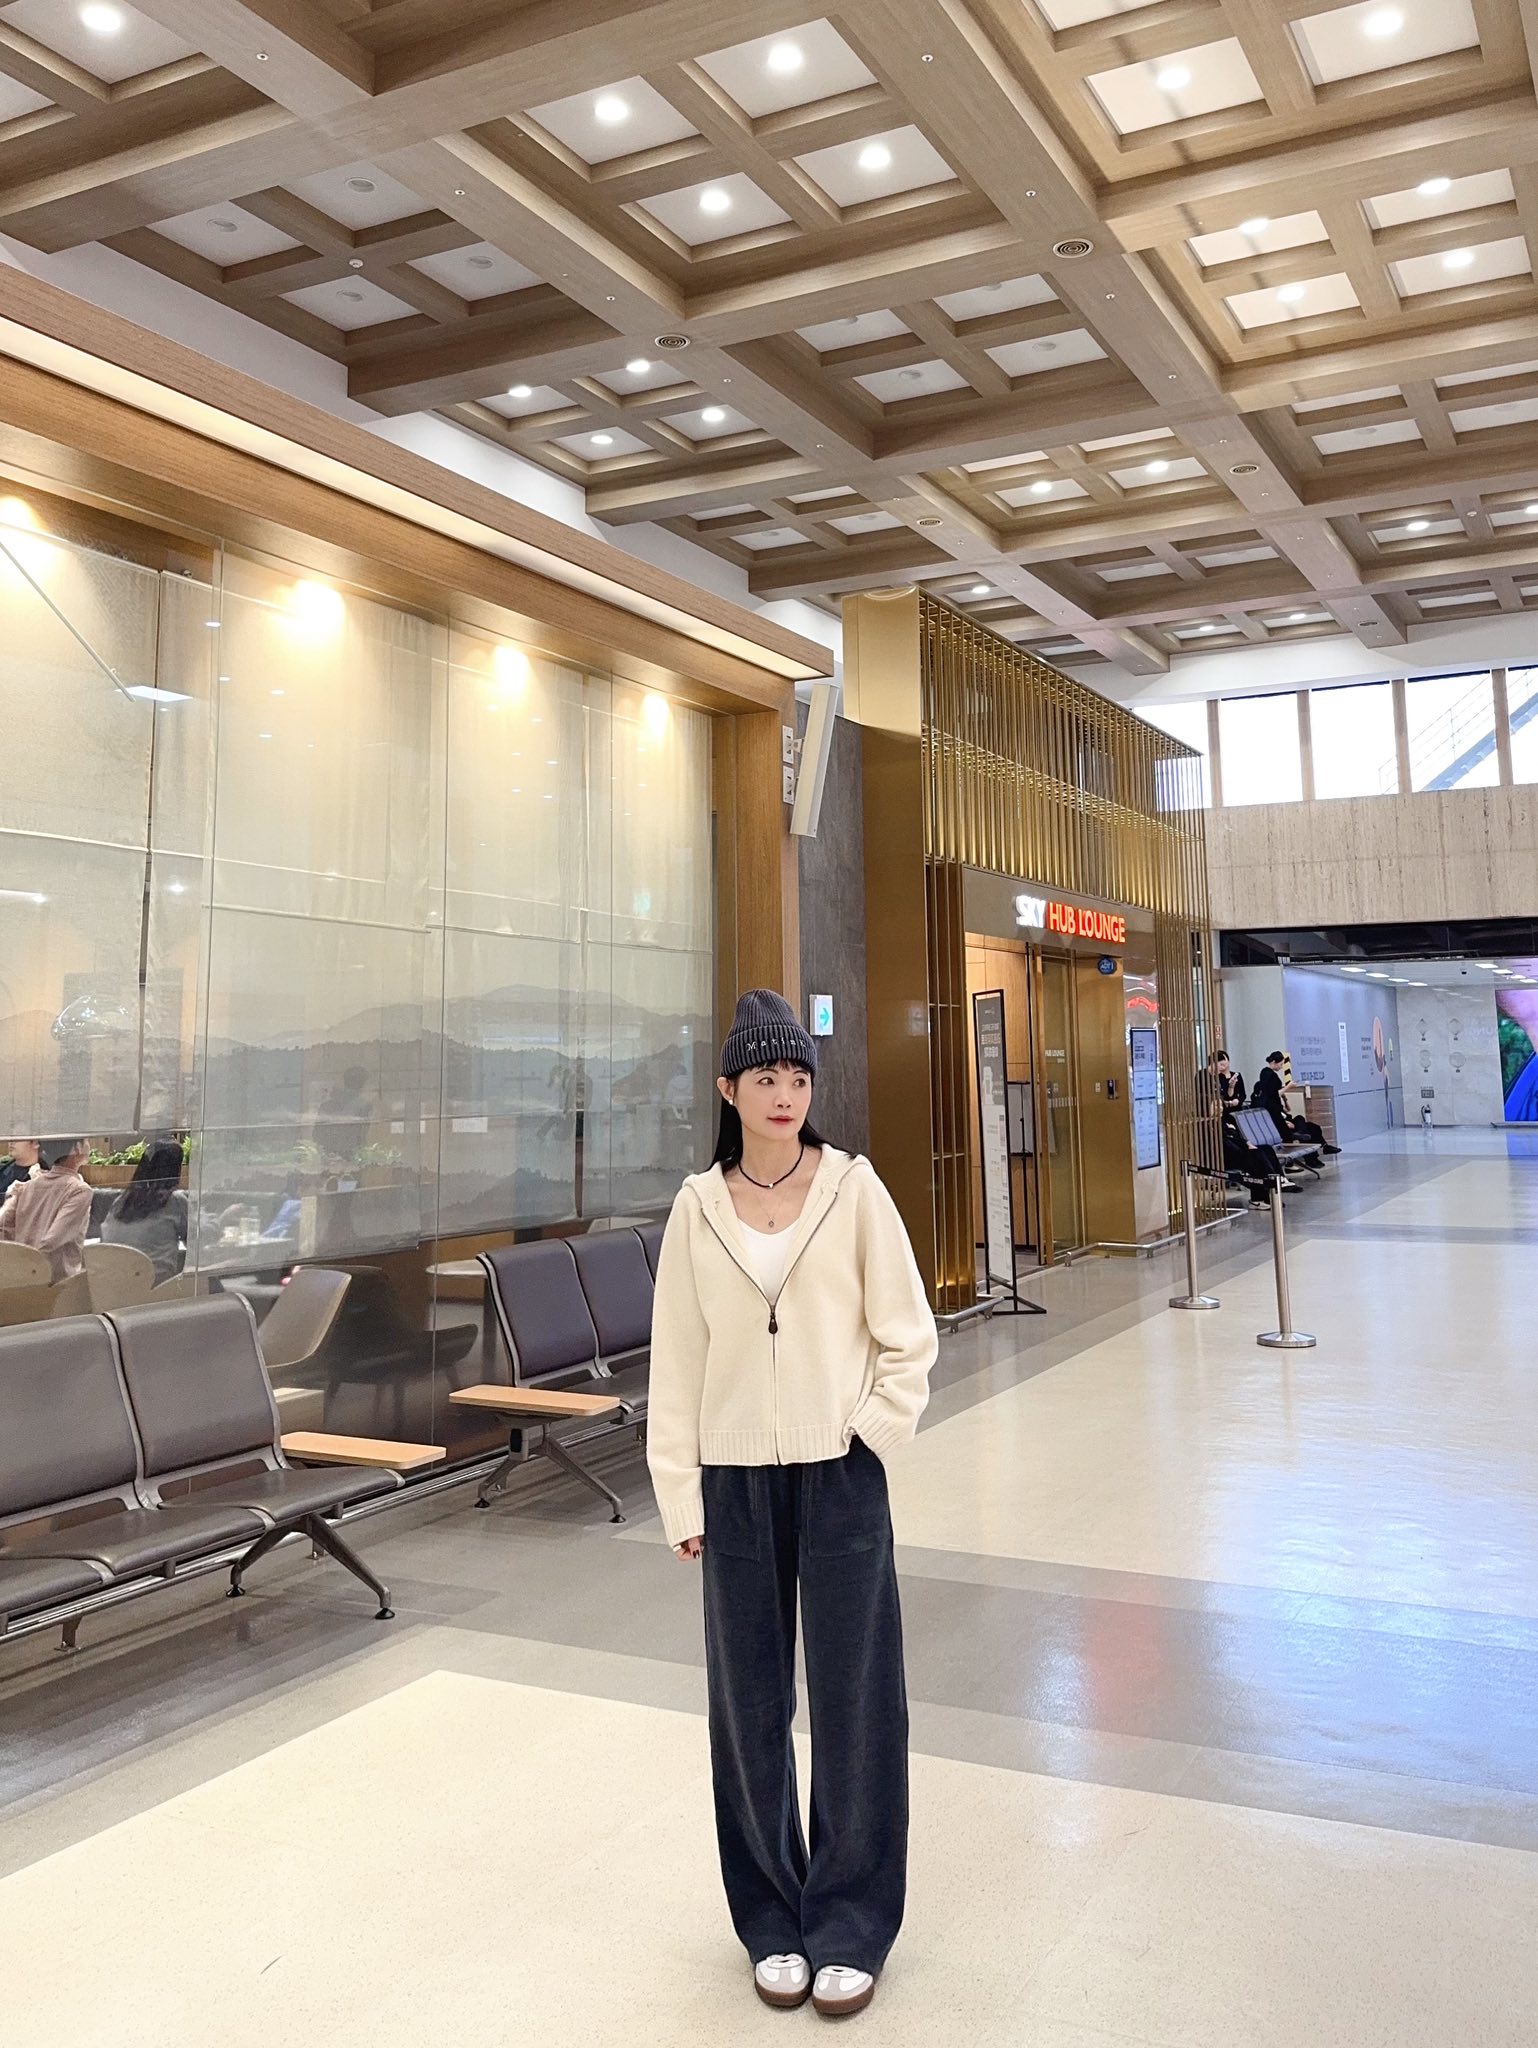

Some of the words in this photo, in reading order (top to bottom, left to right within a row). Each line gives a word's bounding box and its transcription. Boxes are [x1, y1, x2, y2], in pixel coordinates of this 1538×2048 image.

[1015, 895, 1046, 928] SKY
[1049, 902, 1076, 934] HUB
[1079, 909, 1126, 943] LOUNGE
